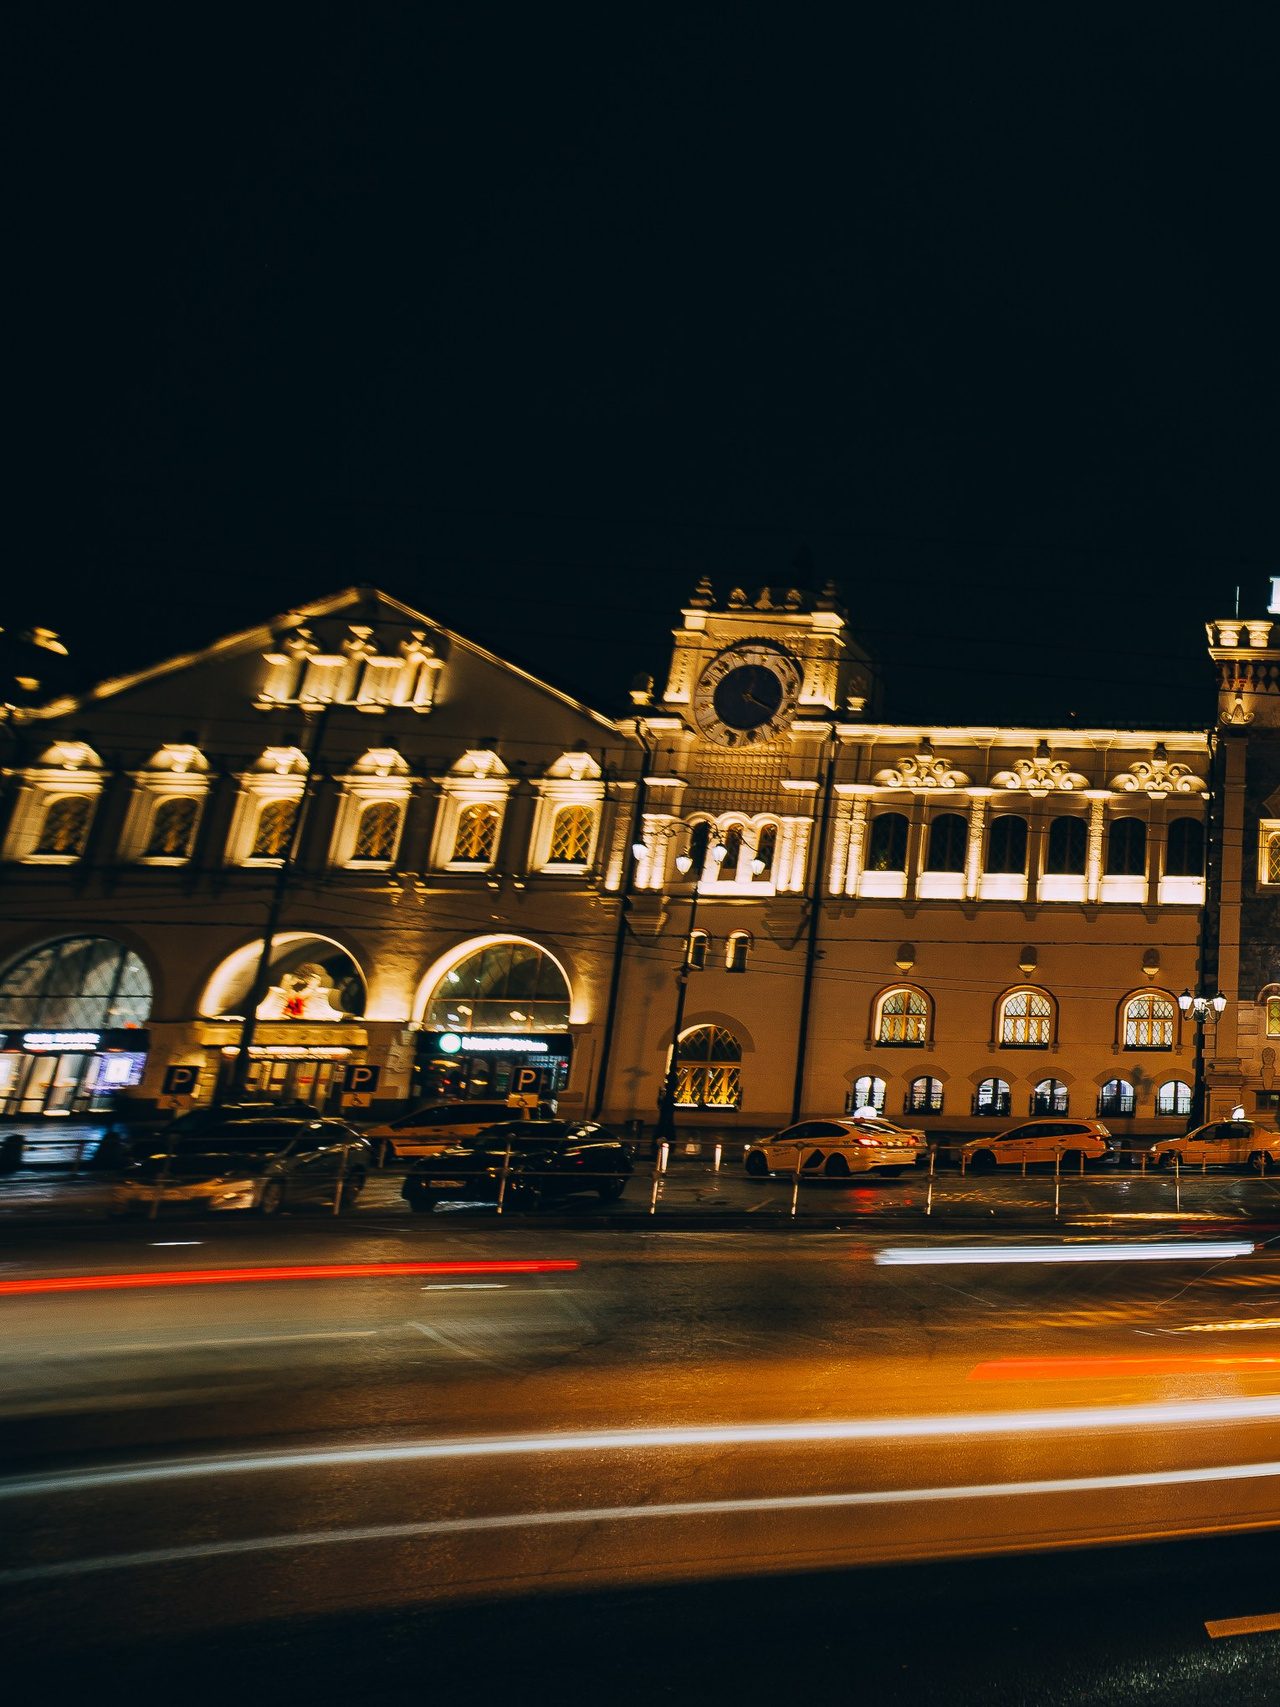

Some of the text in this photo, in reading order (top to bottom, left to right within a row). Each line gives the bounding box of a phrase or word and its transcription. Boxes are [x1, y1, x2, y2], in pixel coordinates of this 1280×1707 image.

[170, 1069, 191, 1091] P
[353, 1068, 373, 1090] P
[518, 1069, 537, 1091] P
